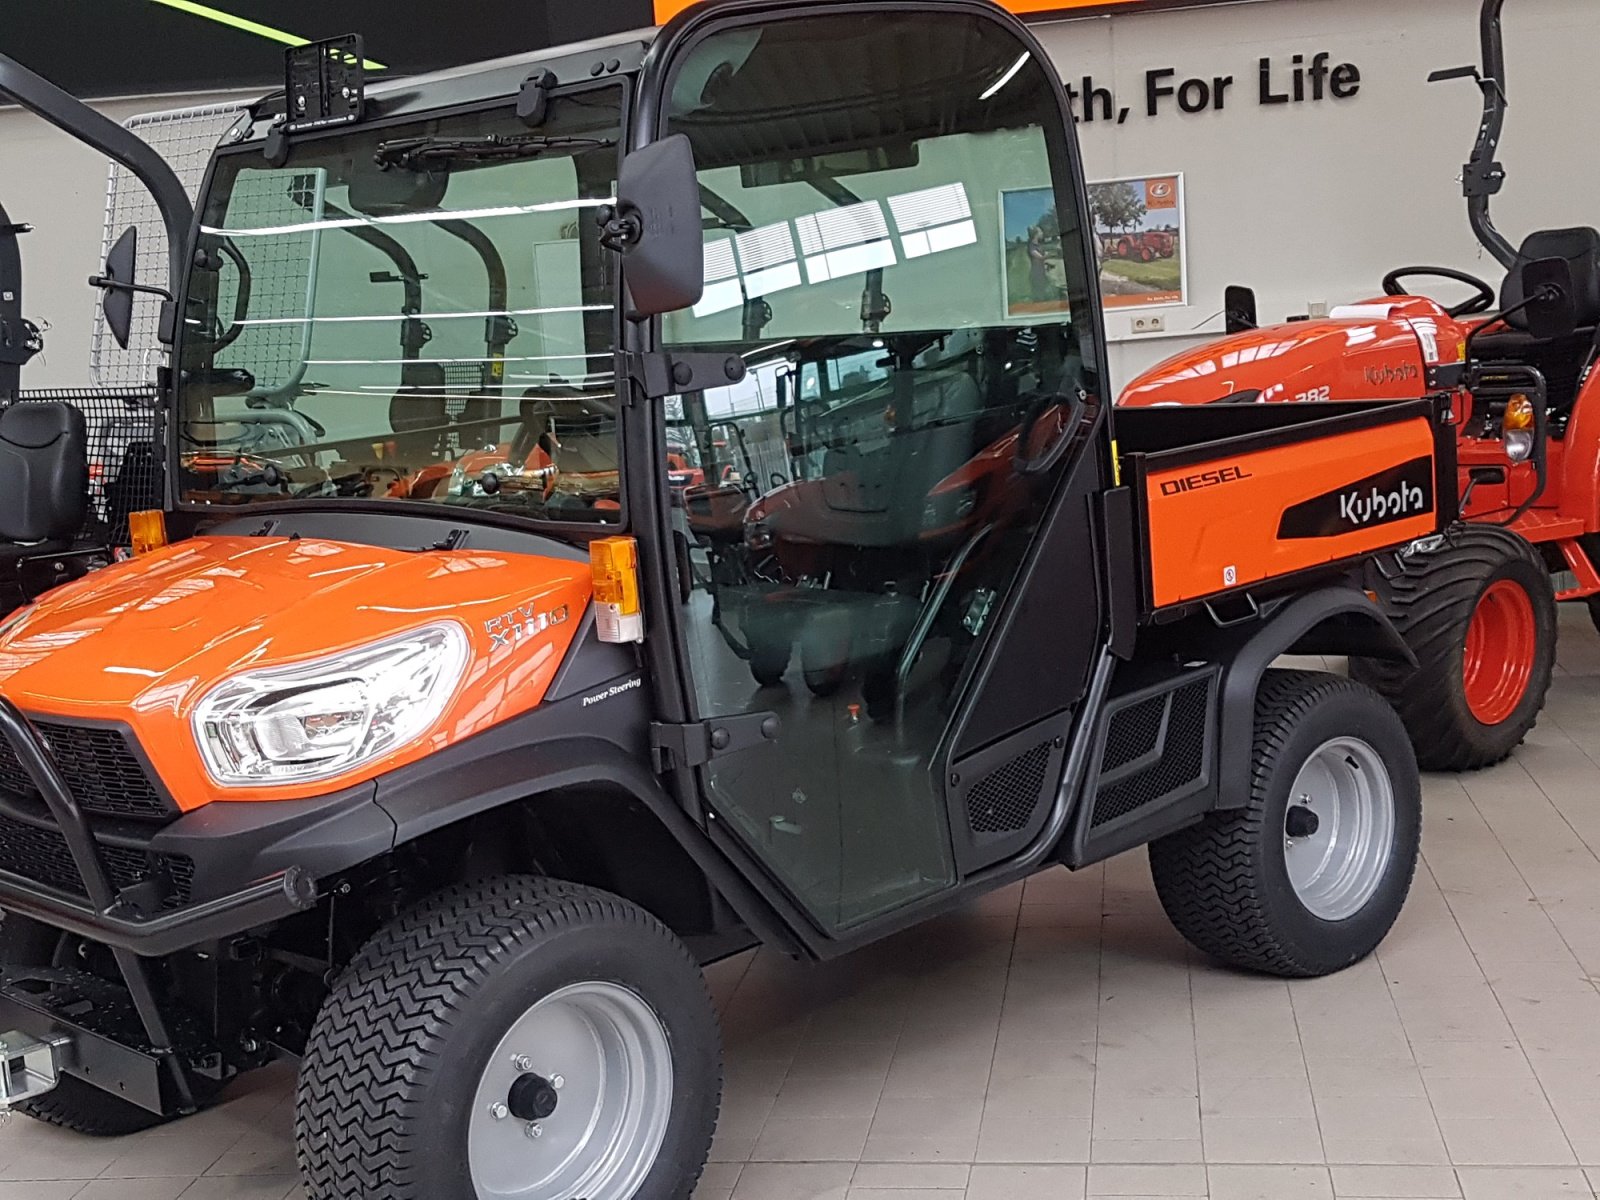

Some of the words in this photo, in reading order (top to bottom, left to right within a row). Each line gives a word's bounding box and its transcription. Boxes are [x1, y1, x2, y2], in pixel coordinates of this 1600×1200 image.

[1146, 68, 1233, 116] For
[1259, 52, 1360, 105] Life
[1364, 360, 1419, 386] Kubota
[1282, 385, 1330, 402] 382
[1161, 466, 1252, 497] DIESEL
[1340, 480, 1424, 525] Kubota
[484, 602, 535, 633] RTV
[582, 691, 609, 707] Power
[609, 677, 642, 697] Steering
